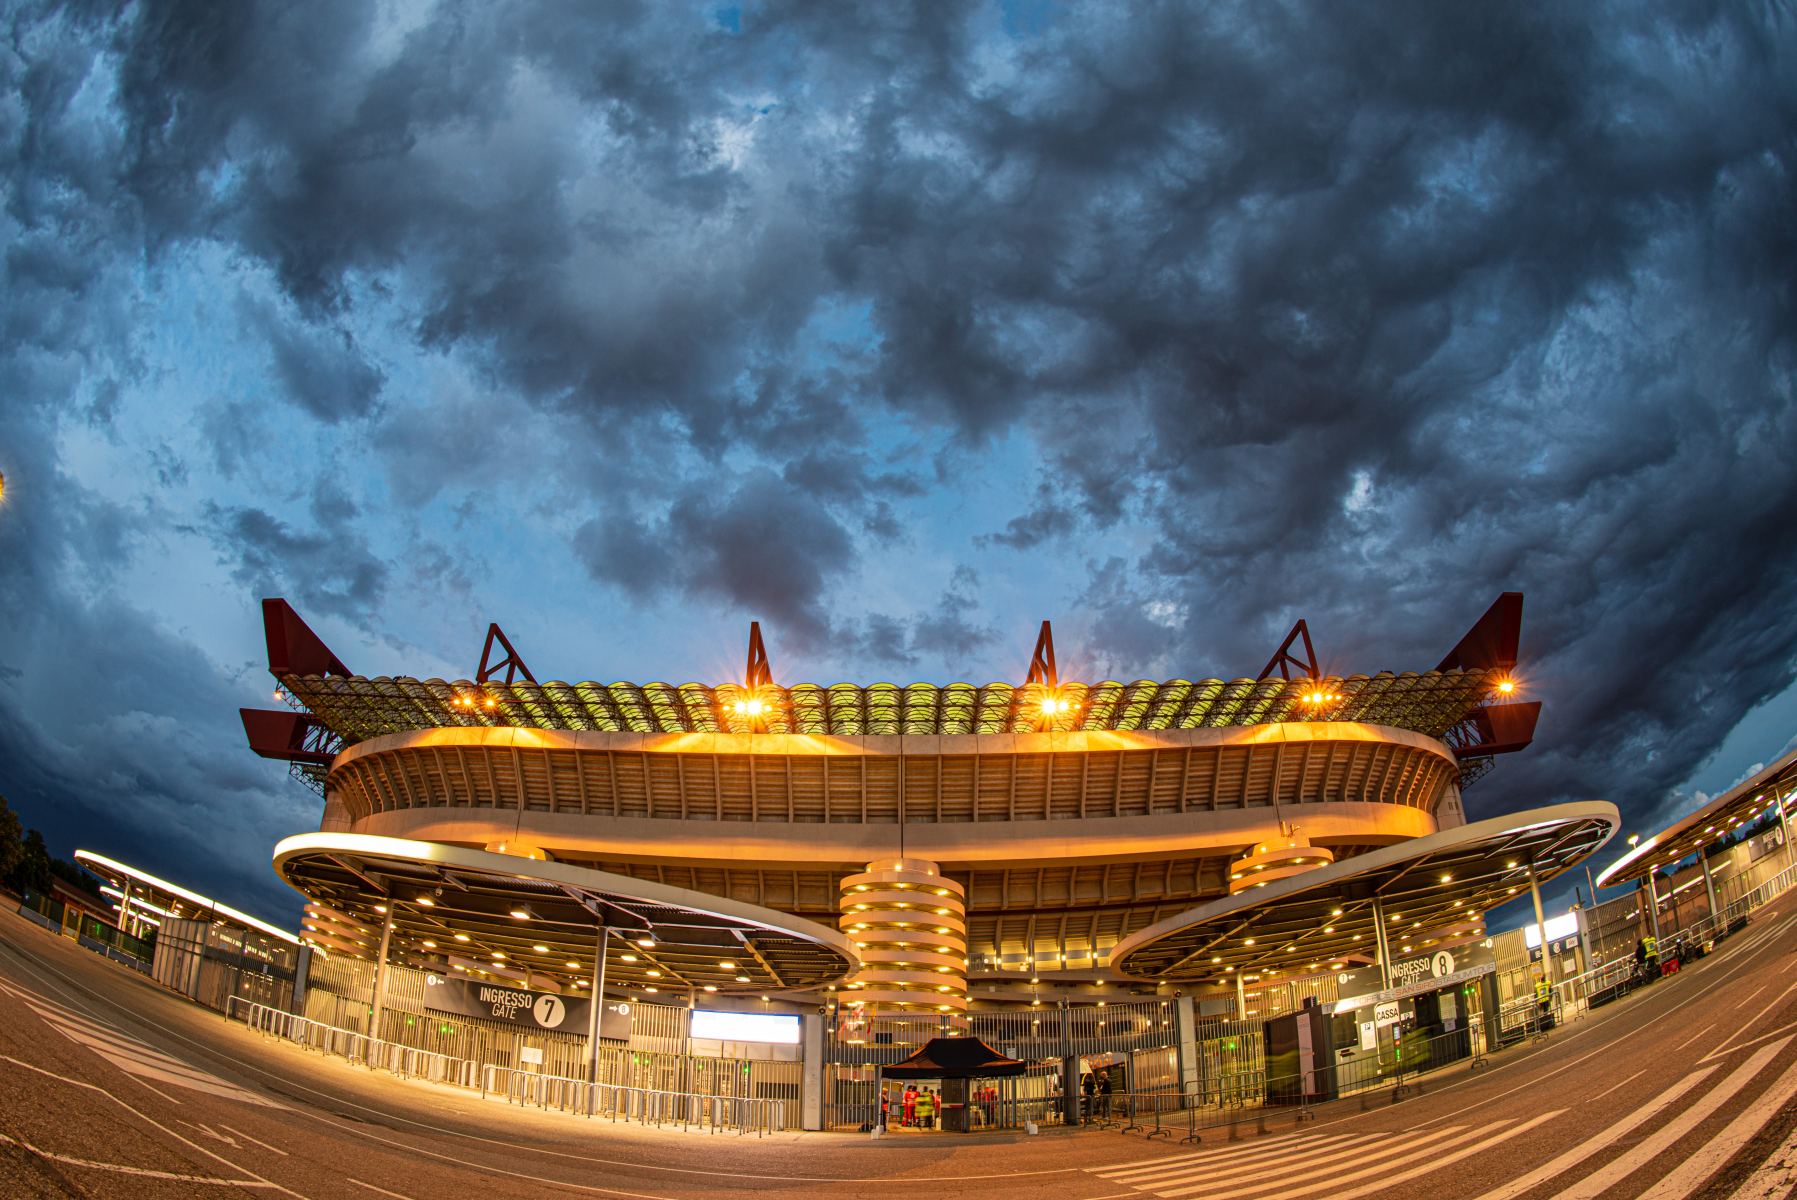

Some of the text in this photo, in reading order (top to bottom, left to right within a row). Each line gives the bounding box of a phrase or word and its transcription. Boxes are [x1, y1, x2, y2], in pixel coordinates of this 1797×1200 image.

[1391, 956, 1447, 979] NGRESSO 8
[1396, 985, 1414, 998] SAN
[1416, 981, 1435, 992] SIRO
[1437, 969, 1472, 986] STADIUM
[1473, 963, 1494, 975] TOUR
[1402, 973, 1420, 986] GATE
[480, 986, 556, 1023] INGRESSO 7
[492, 1002, 517, 1020] GATE
[1376, 1008, 1399, 1021] CASSA
